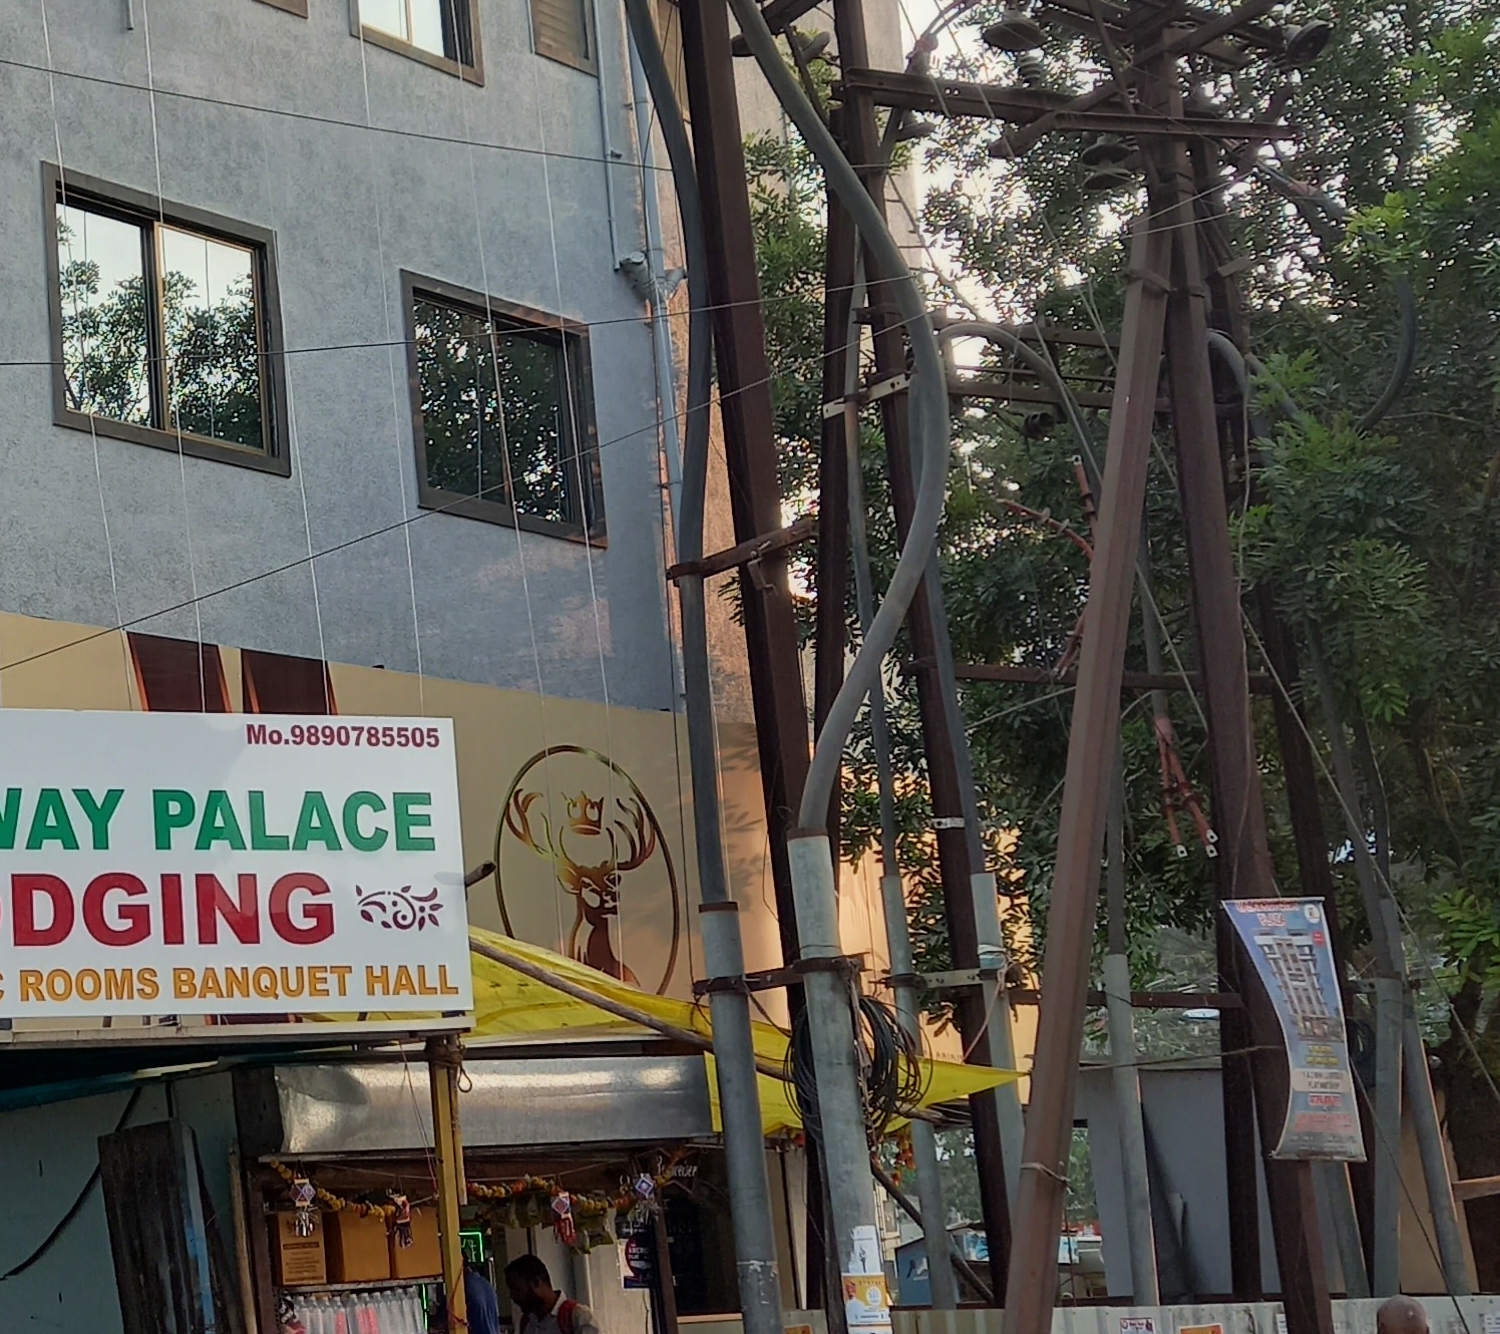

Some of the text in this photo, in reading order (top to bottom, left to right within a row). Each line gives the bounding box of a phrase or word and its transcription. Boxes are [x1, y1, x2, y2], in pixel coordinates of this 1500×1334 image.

[245, 723, 440, 748] Mo.9890785505
[152, 788, 436, 852] PALACE
[19, 968, 160, 1002] ROOMS
[172, 966, 352, 1000] BANQUET
[365, 964, 459, 996] HALL
